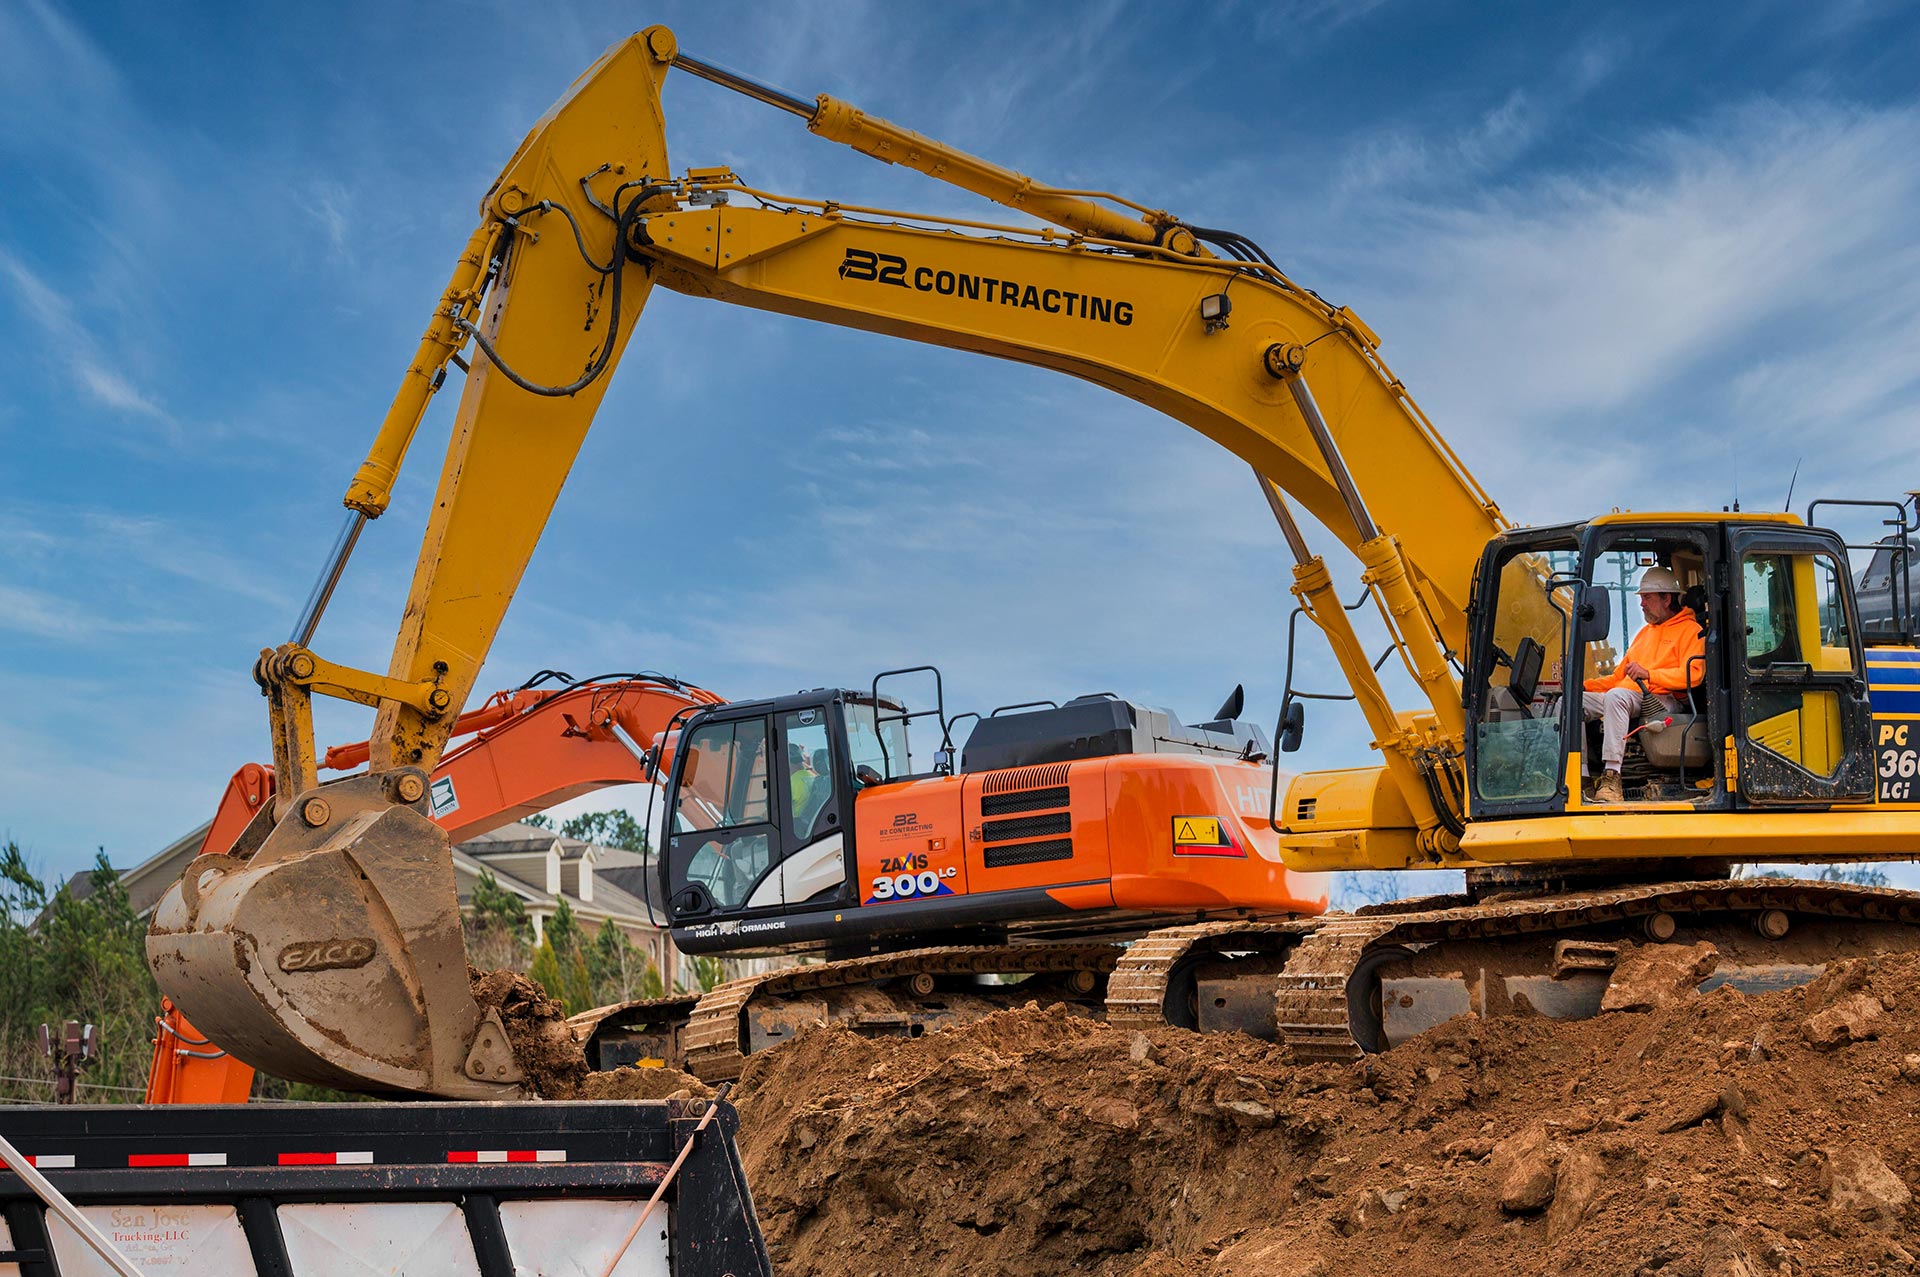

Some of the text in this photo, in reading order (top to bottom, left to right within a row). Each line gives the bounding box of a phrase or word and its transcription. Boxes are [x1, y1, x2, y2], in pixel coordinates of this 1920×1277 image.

[914, 266, 1134, 326] CONTRACTING
[1878, 724, 1908, 746] PC
[1879, 749, 1920, 778] 36
[1881, 781, 1911, 799] LCi
[436, 802, 456, 816] COWIN
[889, 823, 933, 834] CONTRACTING
[881, 852, 929, 873] ZAXIS
[872, 867, 957, 901] 300 LC
[695, 928, 718, 938] HIGH
[111, 1209, 146, 1228] San
[111, 1230, 190, 1243] Trucking, LLC
